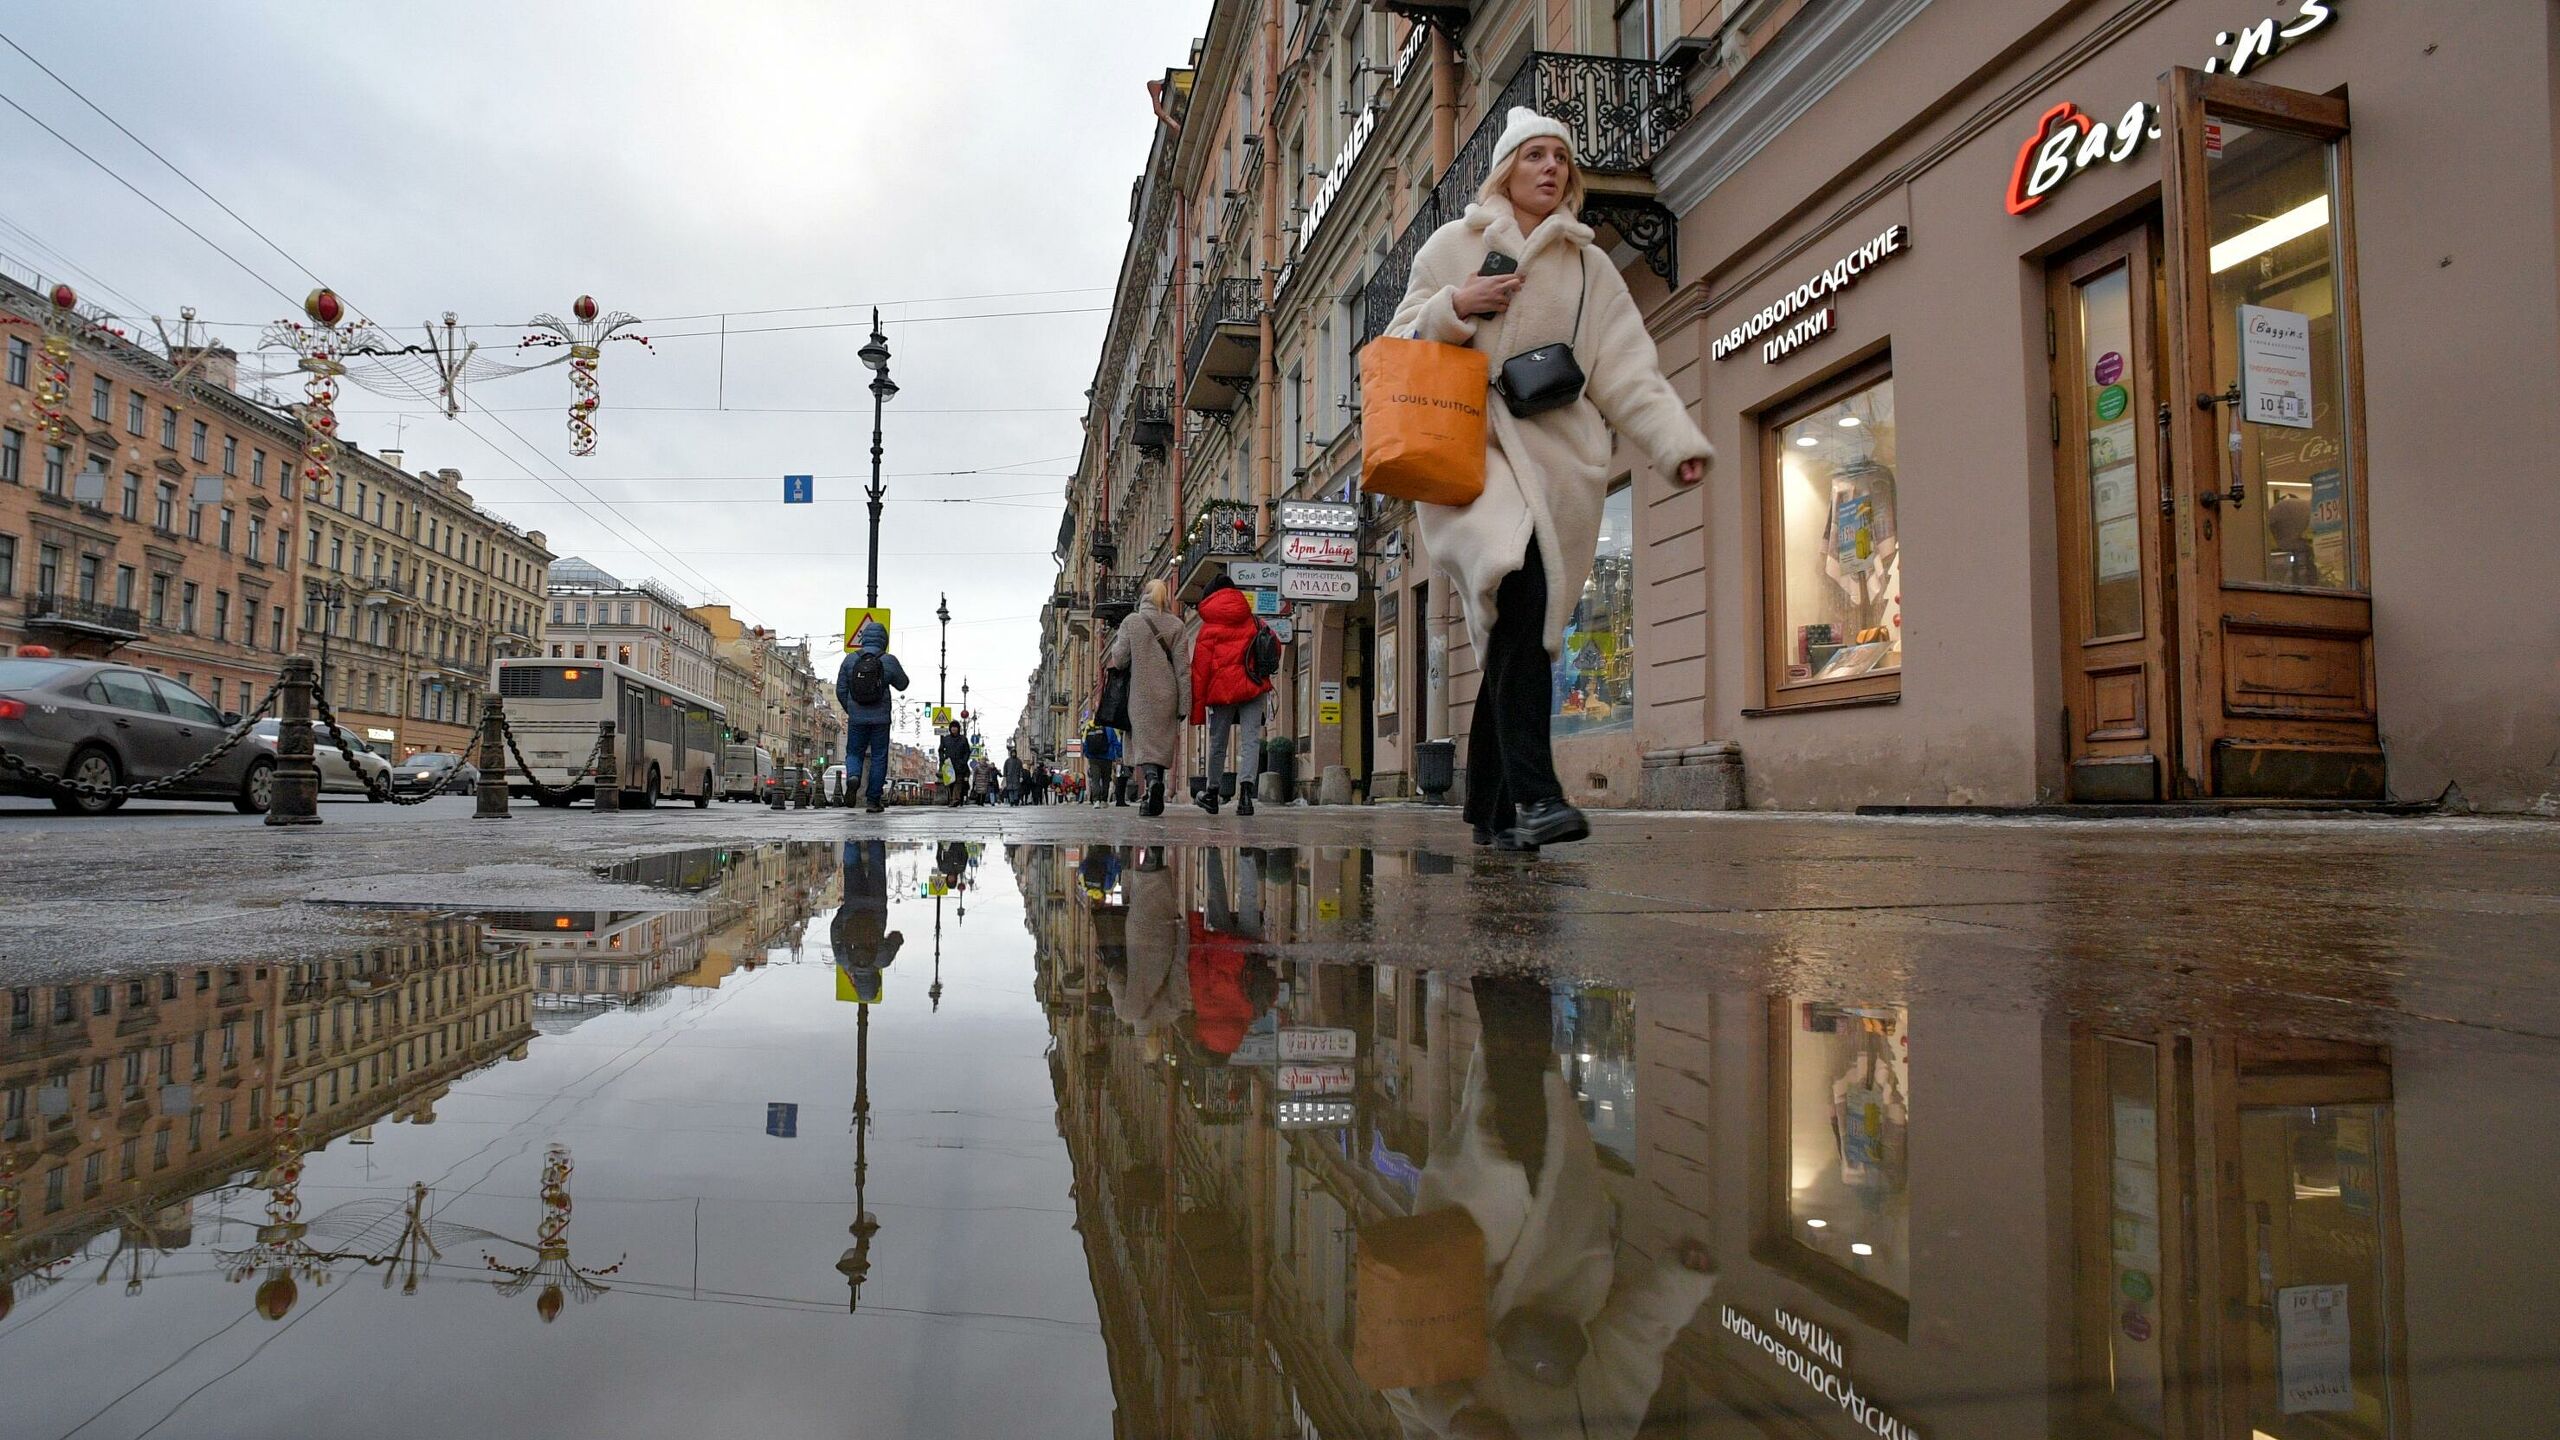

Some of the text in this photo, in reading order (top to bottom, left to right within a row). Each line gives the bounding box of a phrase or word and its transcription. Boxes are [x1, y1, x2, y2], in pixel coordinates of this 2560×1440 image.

[2027, 0, 2329, 197] Bagins
[1711, 224, 1900, 362] ПАВЛОВОПОСАДСКИЕ
[1763, 307, 1829, 365] ПЛАТКИ
[2256, 322, 2304, 340] Baggins
[1391, 393, 1481, 417] LOUIS VUITTON
[2260, 397, 2274, 412] 10
[1287, 537, 1355, 564] Арт Лайф
